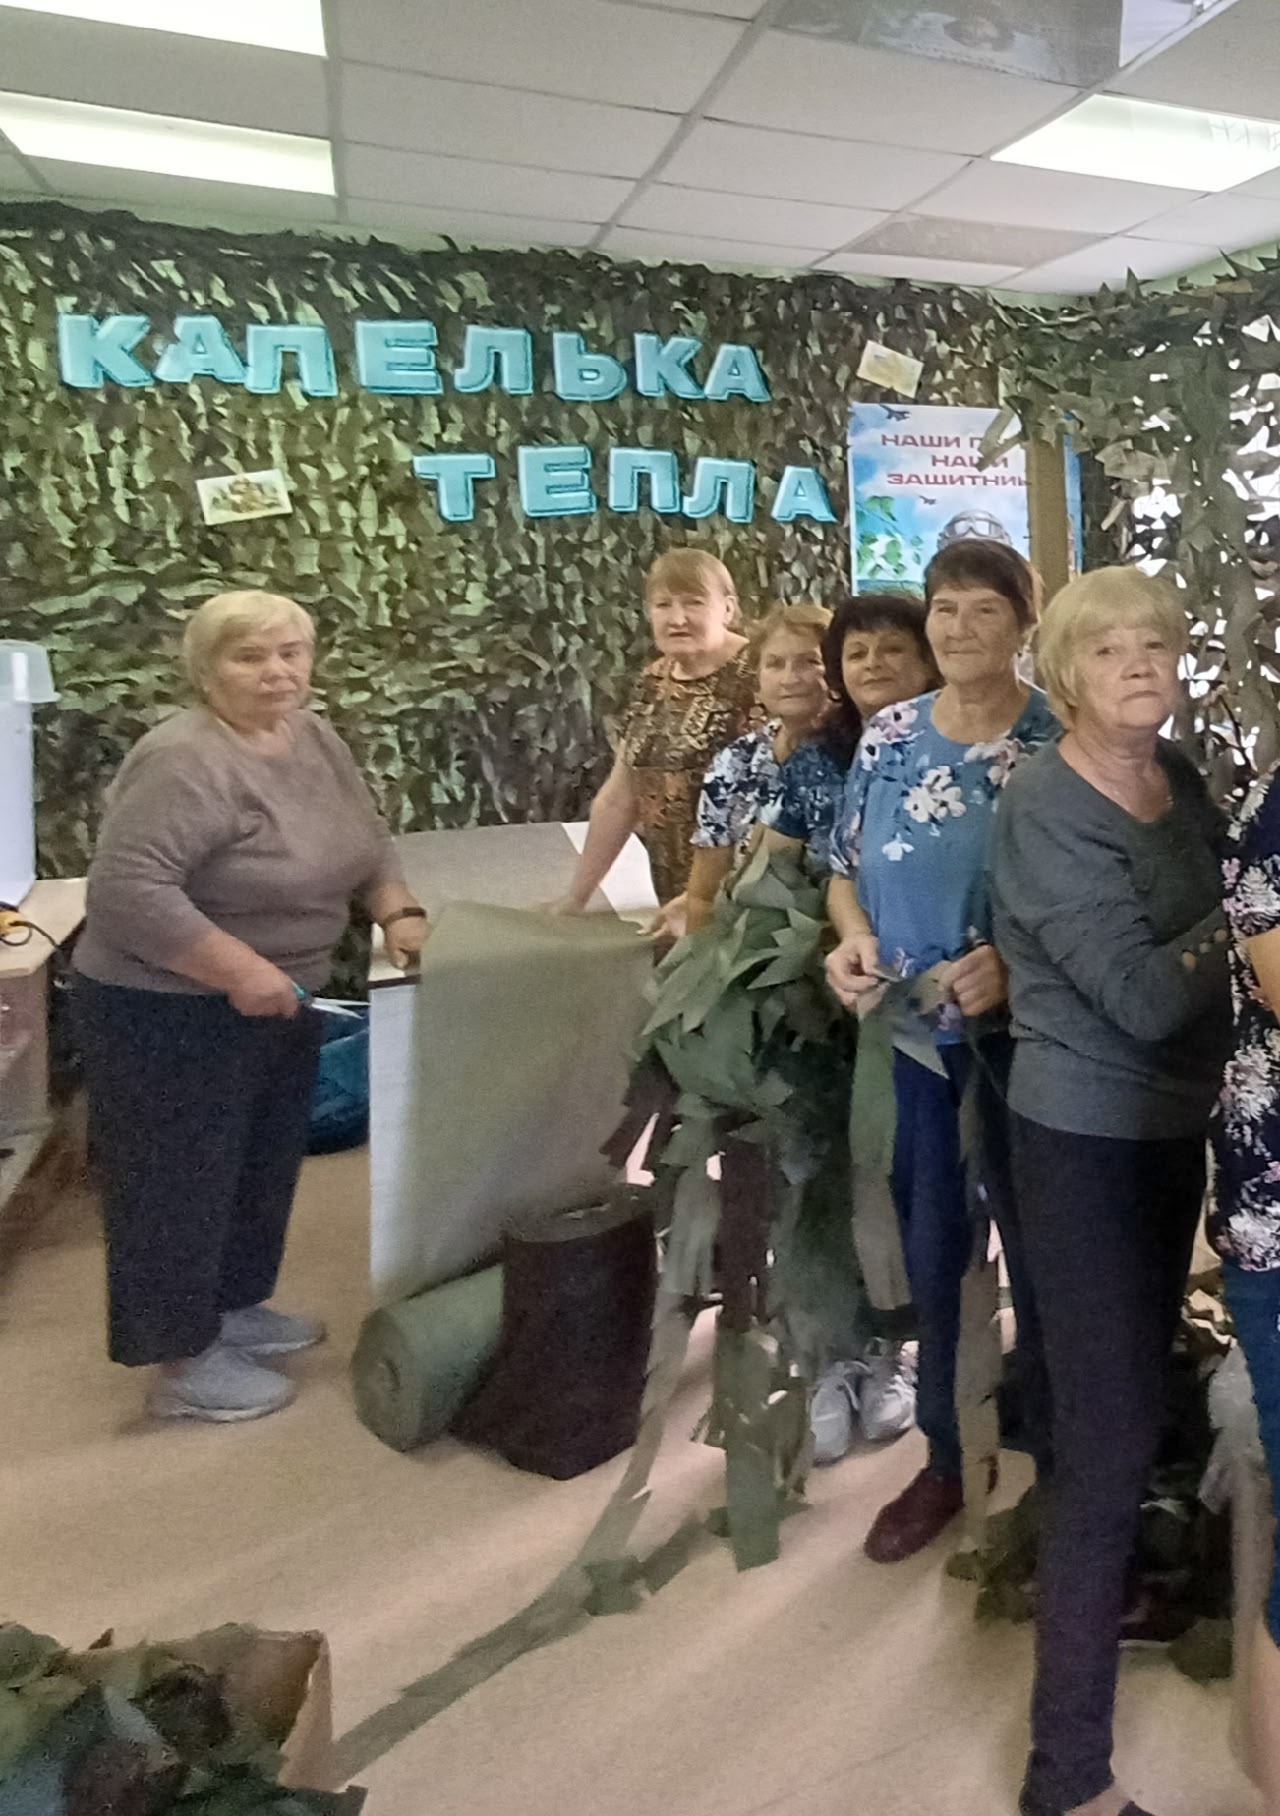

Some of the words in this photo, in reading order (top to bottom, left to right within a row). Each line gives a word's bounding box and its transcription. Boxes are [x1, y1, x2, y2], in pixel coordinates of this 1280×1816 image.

[57, 312, 771, 402] КАПЕЛЬКА
[881, 434, 961, 448] НАШИ
[413, 445, 837, 523] ТЕПЛА
